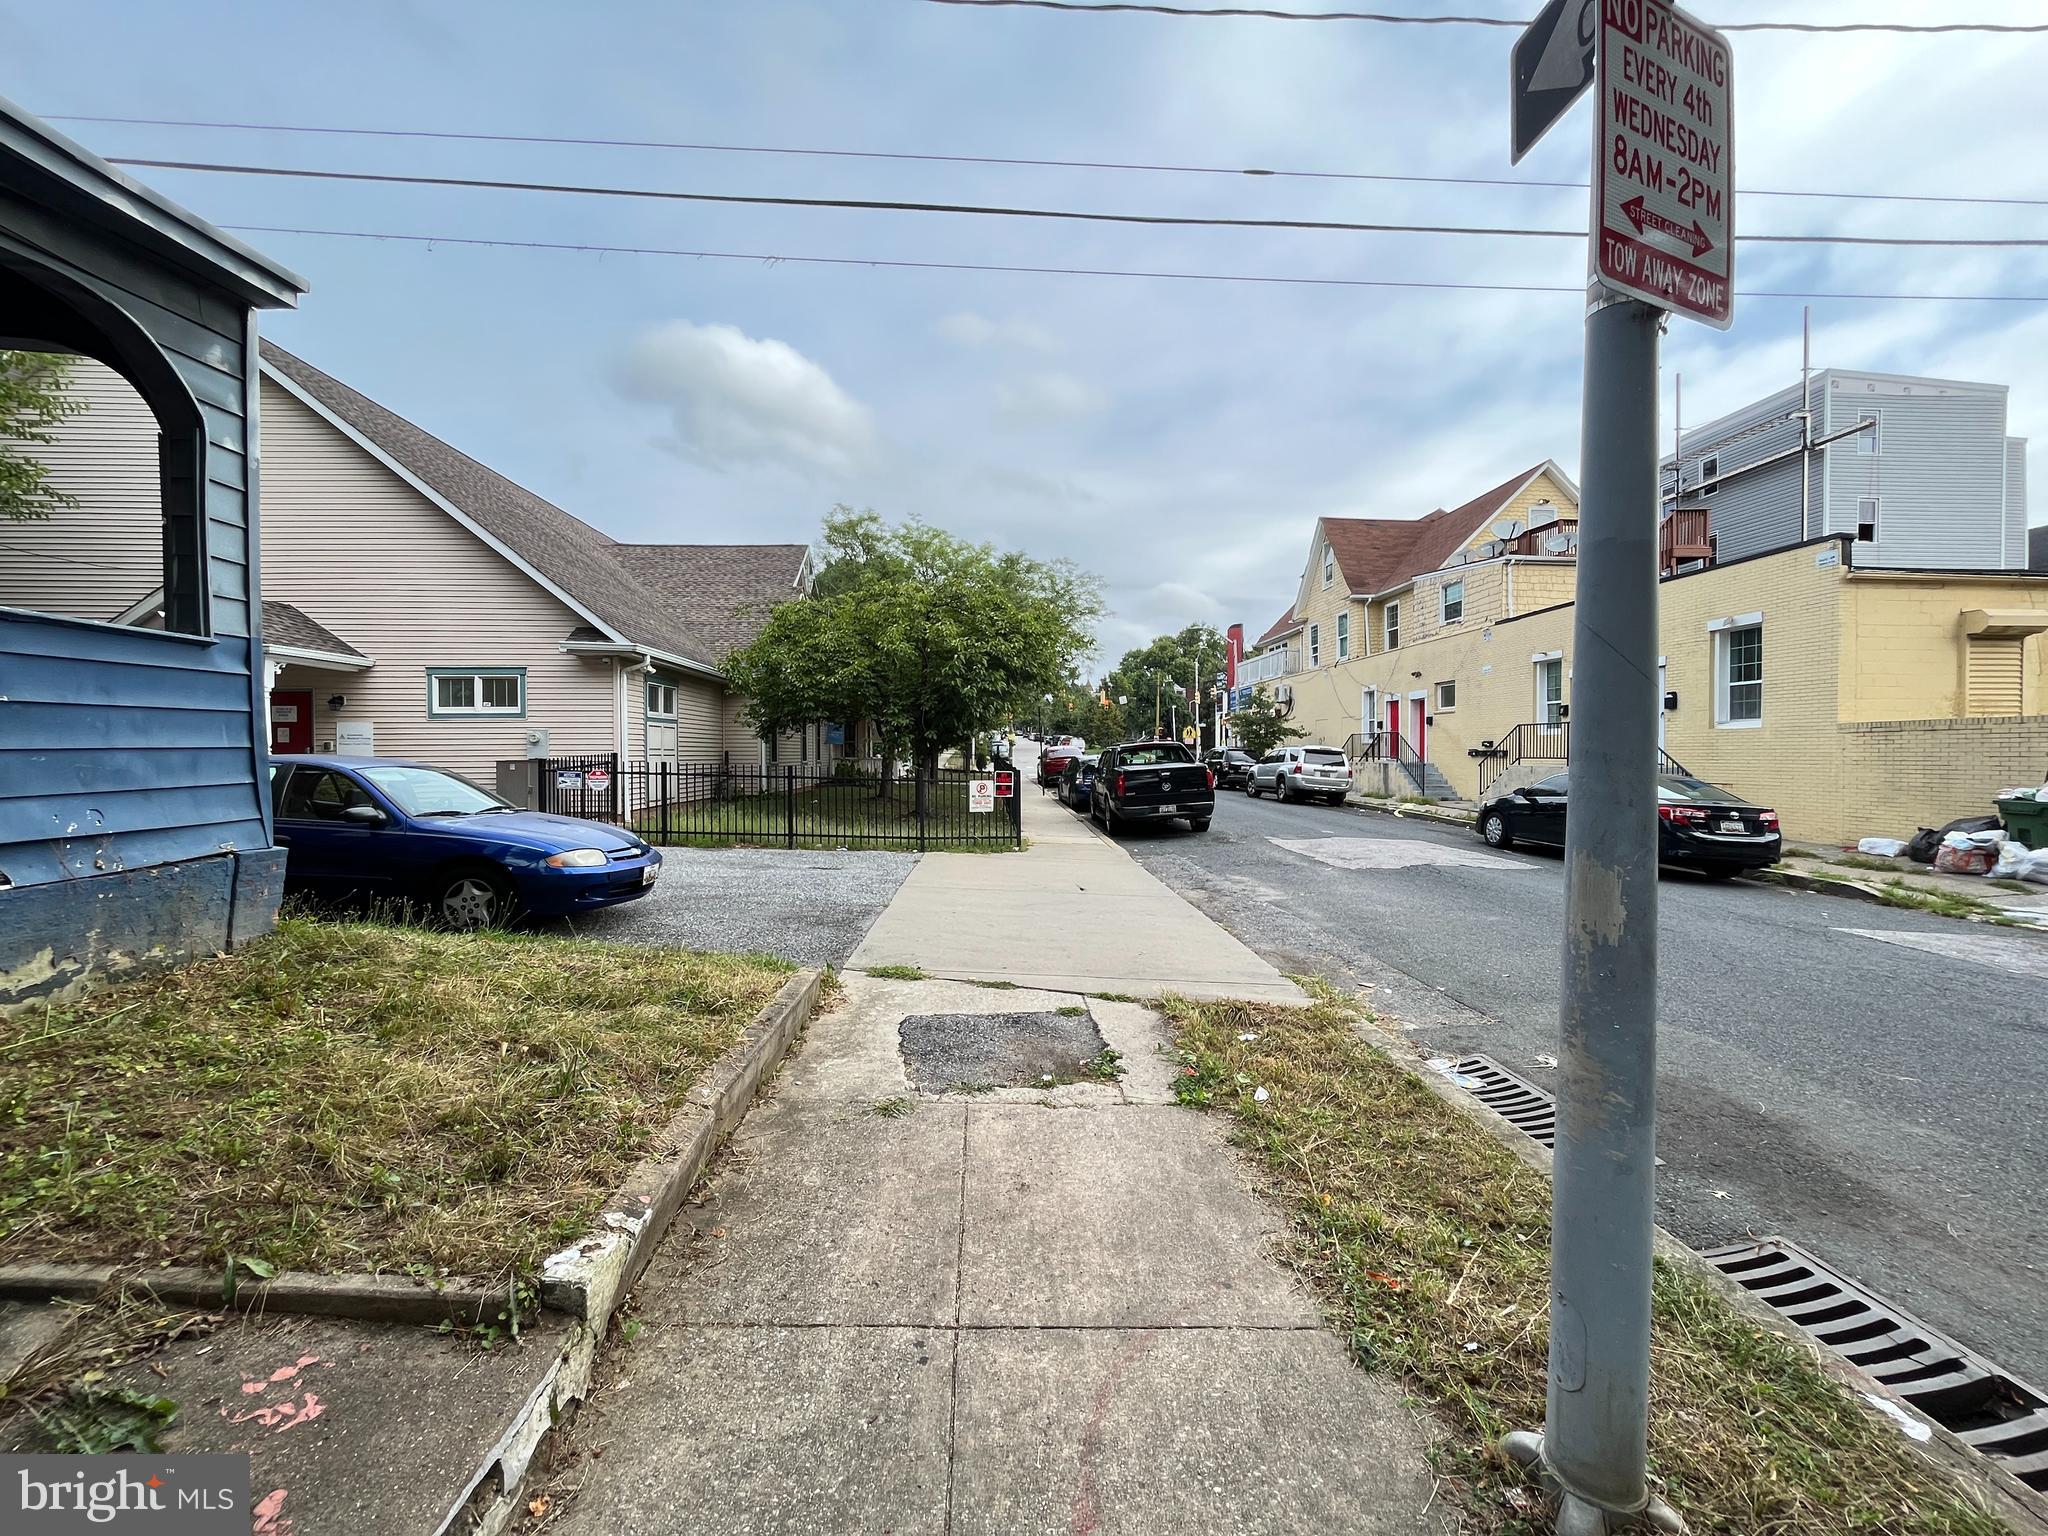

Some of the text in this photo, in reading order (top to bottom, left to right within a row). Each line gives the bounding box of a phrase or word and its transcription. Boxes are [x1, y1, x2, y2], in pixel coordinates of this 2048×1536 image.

[1606, 0, 1639, 35] NO
[1646, 5, 1724, 87] PARKING
[1623, 45, 1712, 127] EVERY 4th
[1613, 87, 1720, 174] WEDNESDAY
[1613, 134, 1720, 221] 8AM-2PM
[1629, 205, 1706, 249] STREET CLEANING
[1606, 238, 1723, 312] TOW AWAY ZONE
